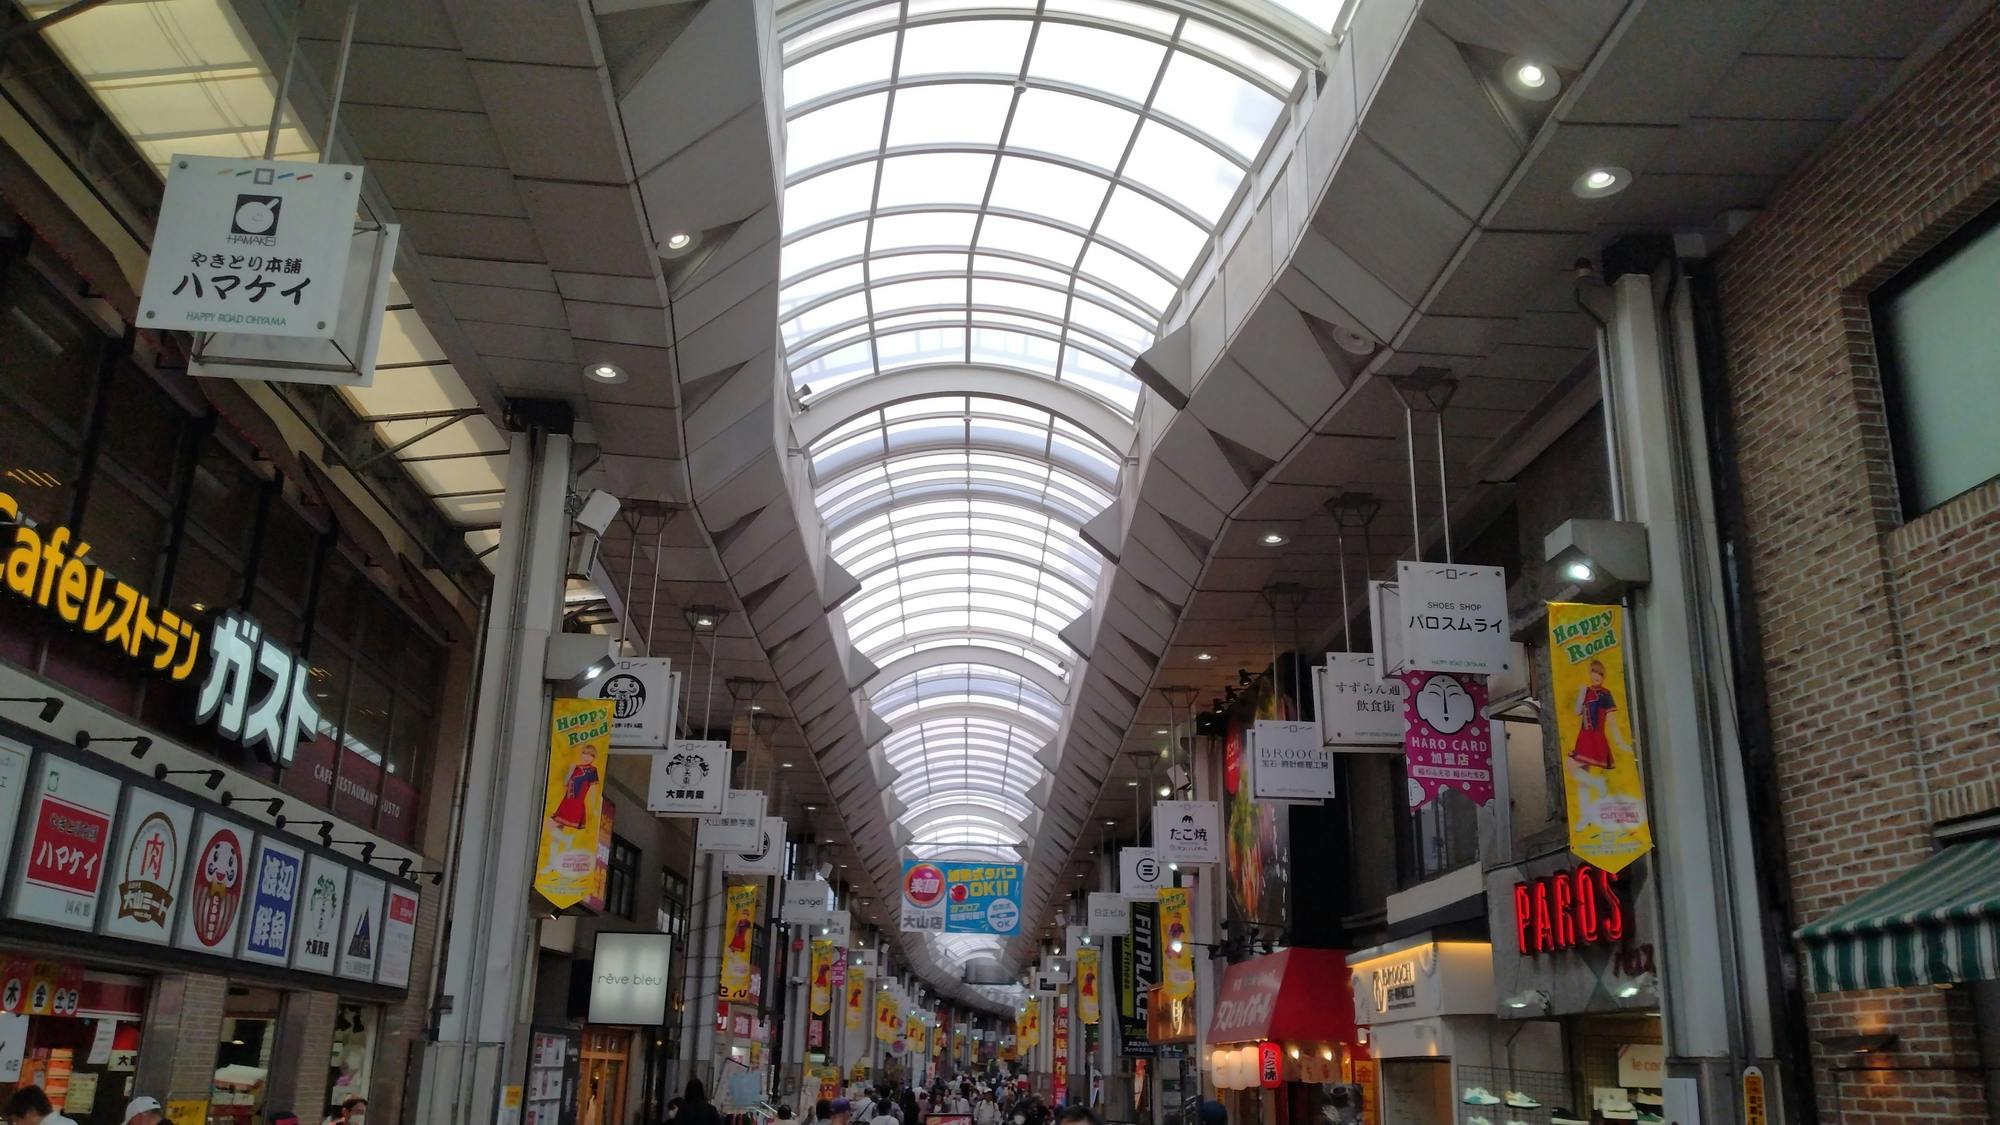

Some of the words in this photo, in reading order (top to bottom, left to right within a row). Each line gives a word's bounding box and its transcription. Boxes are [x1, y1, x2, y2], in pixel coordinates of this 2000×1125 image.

[226, 234, 277, 247] HAMAKEI
[191, 252, 303, 275] やきとり本舗
[172, 273, 311, 306] ハマケイ
[186, 311, 216, 322] HAPPY
[218, 313, 244, 324] ROAD
[245, 315, 287, 326] OHYAMA
[1427, 601, 1455, 610] SHOES
[1459, 602, 1482, 612] SHOP
[1409, 613, 1503, 634] パロスムライ
[1552, 608, 1614, 645] Happy
[1567, 630, 1617, 663] Road
[196, 608, 321, 768] ガスト
[1356, 699, 1395, 713] 飲食街
[555, 707, 608, 731] Happy
[567, 721, 609, 746] Road
[1411, 736, 1447, 750] HARO
[1452, 739, 1488, 752] CARD
[1430, 752, 1469, 766] 加盟店
[1169, 828, 1208, 842] たこ焼
[1513, 862, 1623, 956] PAROS
[903, 914, 943, 930] 大山店
[597, 972, 630, 985] rêve
[632, 975, 663, 987] bleu
